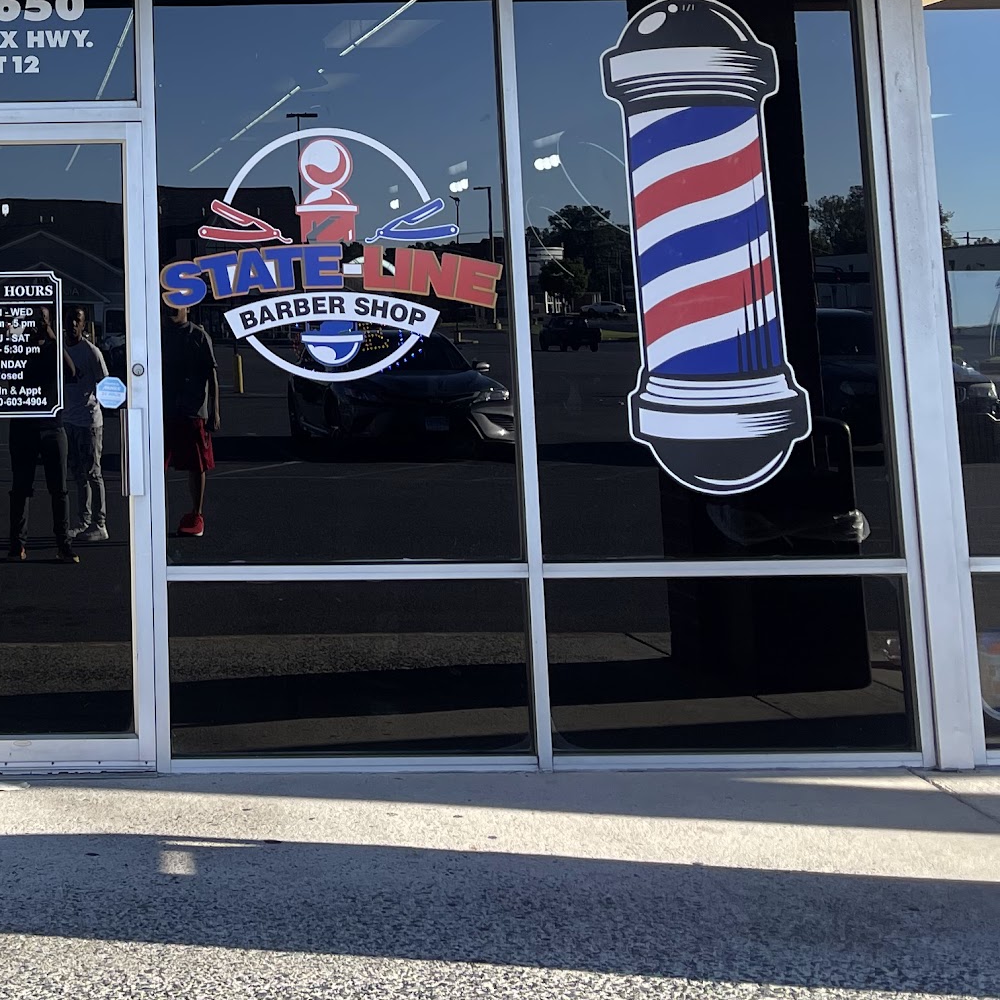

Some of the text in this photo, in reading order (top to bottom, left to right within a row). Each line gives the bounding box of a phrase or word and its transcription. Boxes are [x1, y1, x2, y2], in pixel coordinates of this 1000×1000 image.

[27, 30, 94, 48] HWY.
[12, 55, 40, 74] 12
[4, 285, 54, 297] HOURS
[10, 308, 33, 316] WED
[239, 295, 427, 330] BARBER SHOP
[13, 319, 19, 328] 5
[21, 321, 36, 330] pm
[11, 334, 31, 342] SAT
[4, 345, 24, 354] 5:30
[25, 347, 40, 355] pm
[10, 386, 17, 395] &
[19, 386, 42, 396] Appt
